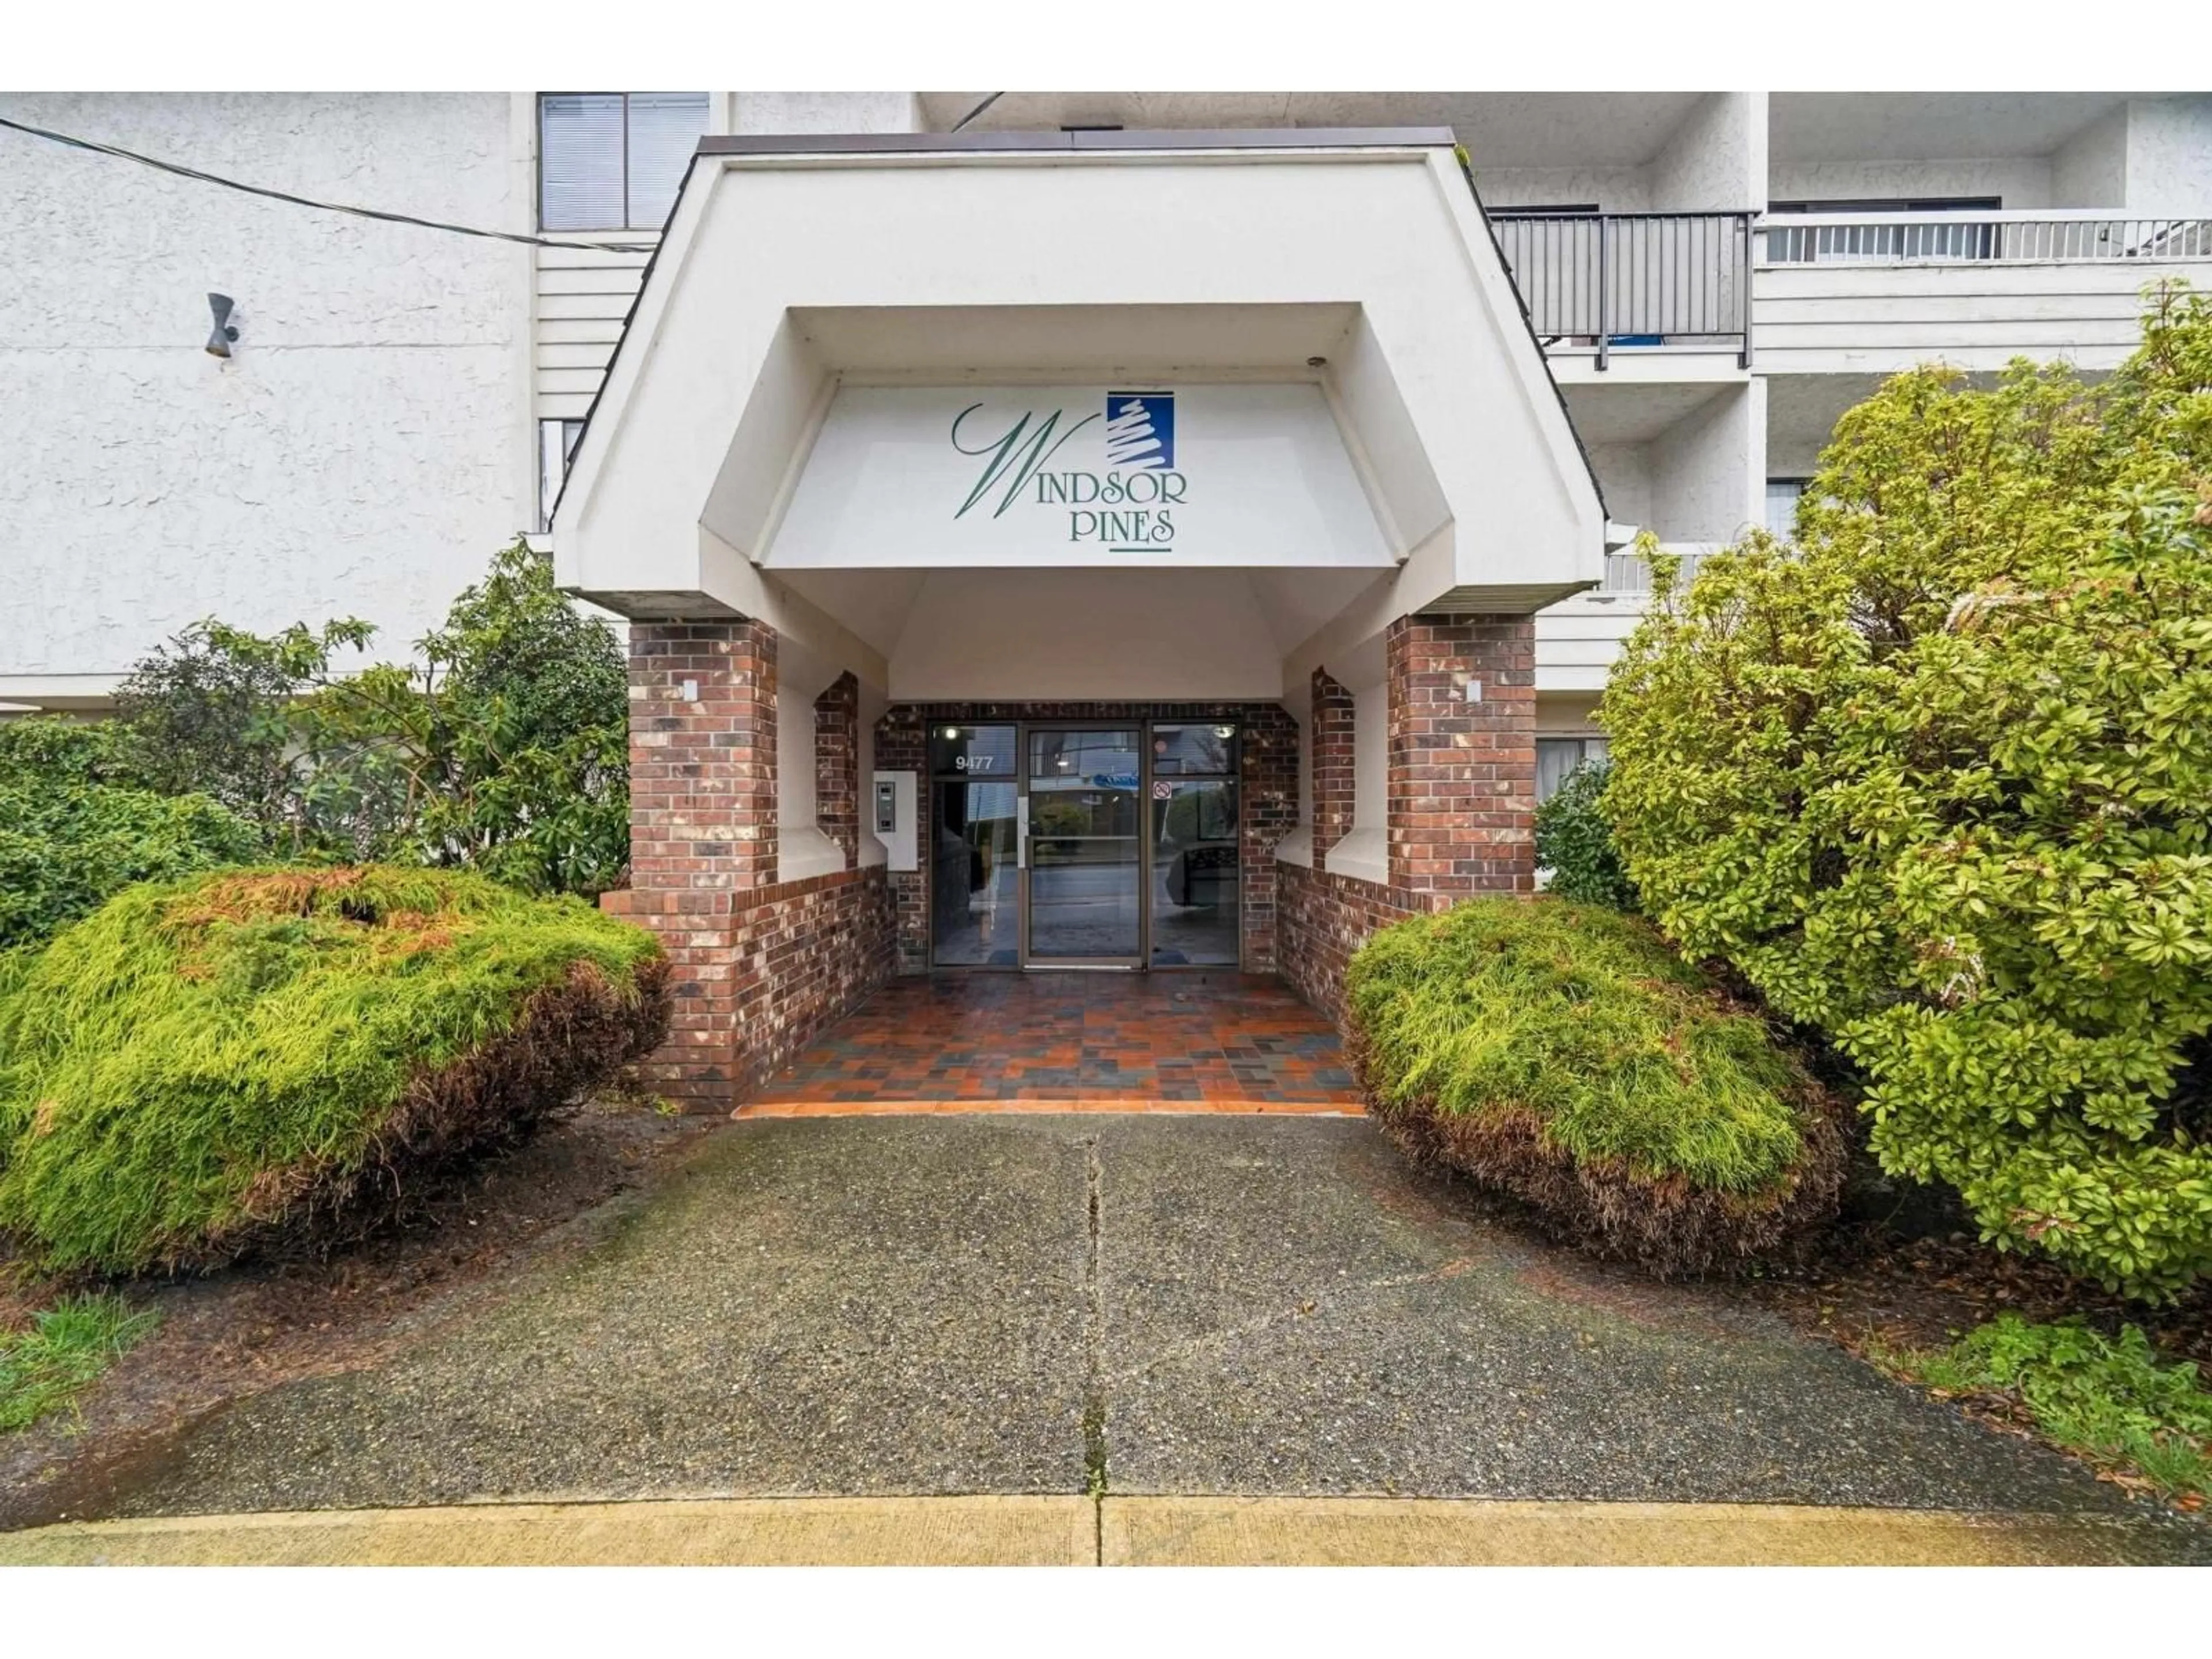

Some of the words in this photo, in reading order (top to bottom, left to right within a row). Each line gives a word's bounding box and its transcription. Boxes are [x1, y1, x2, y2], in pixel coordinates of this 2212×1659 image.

[952, 403, 1188, 520] WINDSOR
[1069, 510, 1175, 543] PINES
[955, 756, 994, 770] 9477
